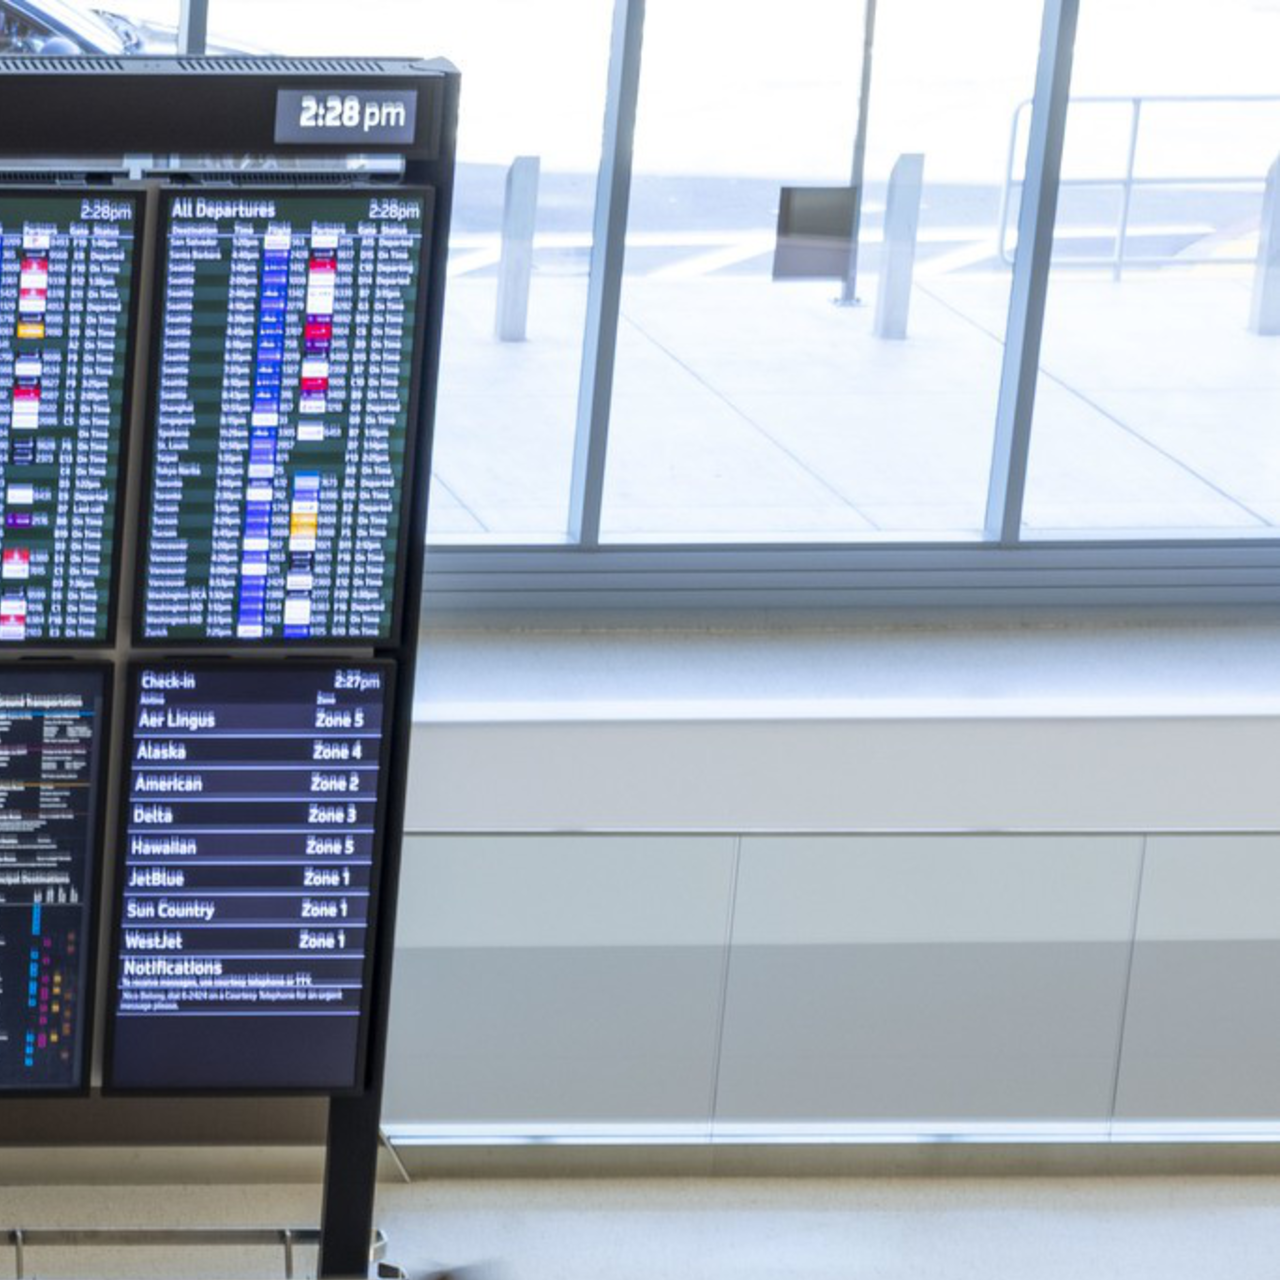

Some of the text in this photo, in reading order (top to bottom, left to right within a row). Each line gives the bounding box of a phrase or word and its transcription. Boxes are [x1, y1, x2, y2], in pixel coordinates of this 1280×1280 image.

[299, 95, 406, 132] 2:28 pm
[80, 202, 131, 220] 2:28pm
[171, 200, 275, 220] All Departures
[369, 202, 420, 220] 2:28pm
[141, 674, 196, 689] Check-in
[334, 672, 380, 690] 2:27pm
[138, 711, 215, 730] Aer Lingus
[315, 711, 364, 727] Zone 5
[137, 743, 186, 759] Alaska
[312, 743, 362, 759] Zone 4
[135, 775, 203, 791] American
[310, 775, 359, 791] Zone 2
[133, 807, 173, 823] Delta
[308, 807, 357, 823] Zone 3
[131, 838, 197, 855] Hawaiian
[305, 838, 354, 855] Zone 5
[128, 870, 185, 886] JetBlue
[303, 870, 350, 886] Zone 1
[127, 901, 215, 921] Sun Country
[301, 901, 348, 918] Zone 1
[125, 932, 183, 949] WestJet
[299, 932, 345, 949] Zone 1
[124, 959, 222, 975] Notifications
